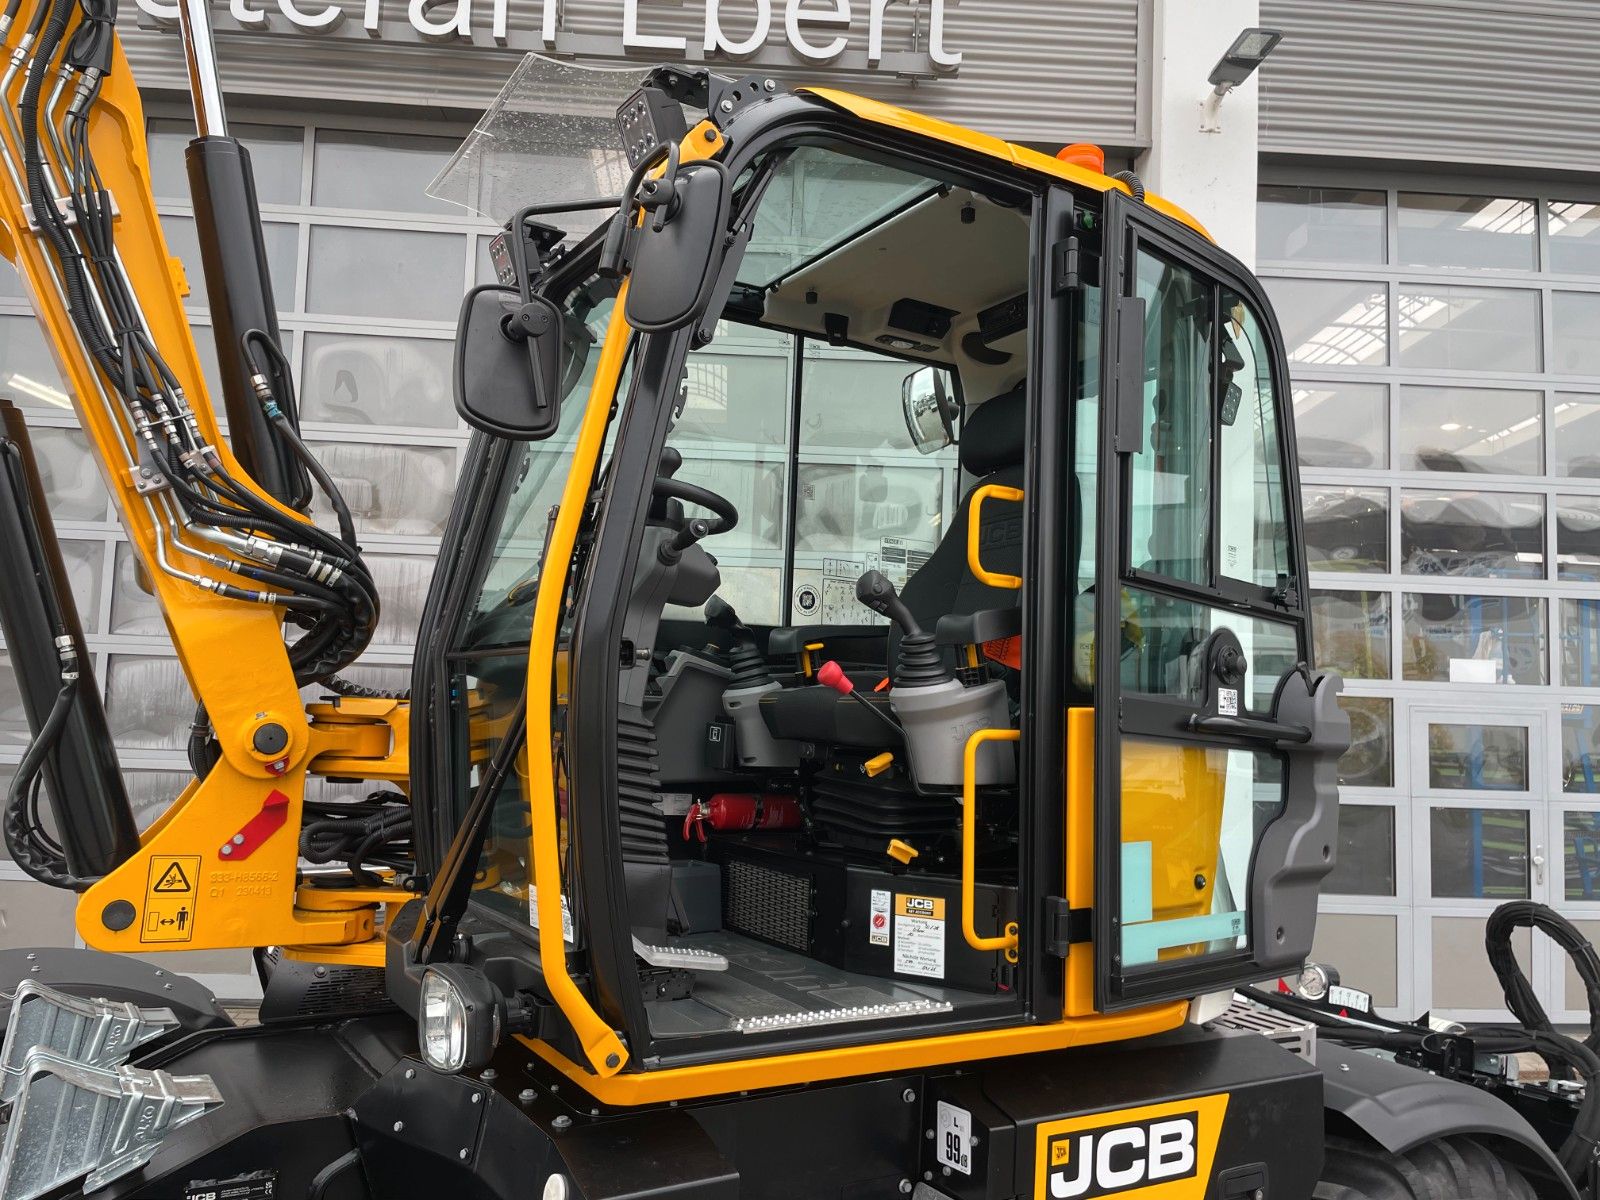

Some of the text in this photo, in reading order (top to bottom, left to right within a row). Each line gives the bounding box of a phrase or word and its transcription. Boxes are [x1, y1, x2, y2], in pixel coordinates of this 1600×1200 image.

[906, 898, 934, 910] JCB
[946, 1131, 961, 1165] 99
[1050, 1118, 1195, 1199] JCB
